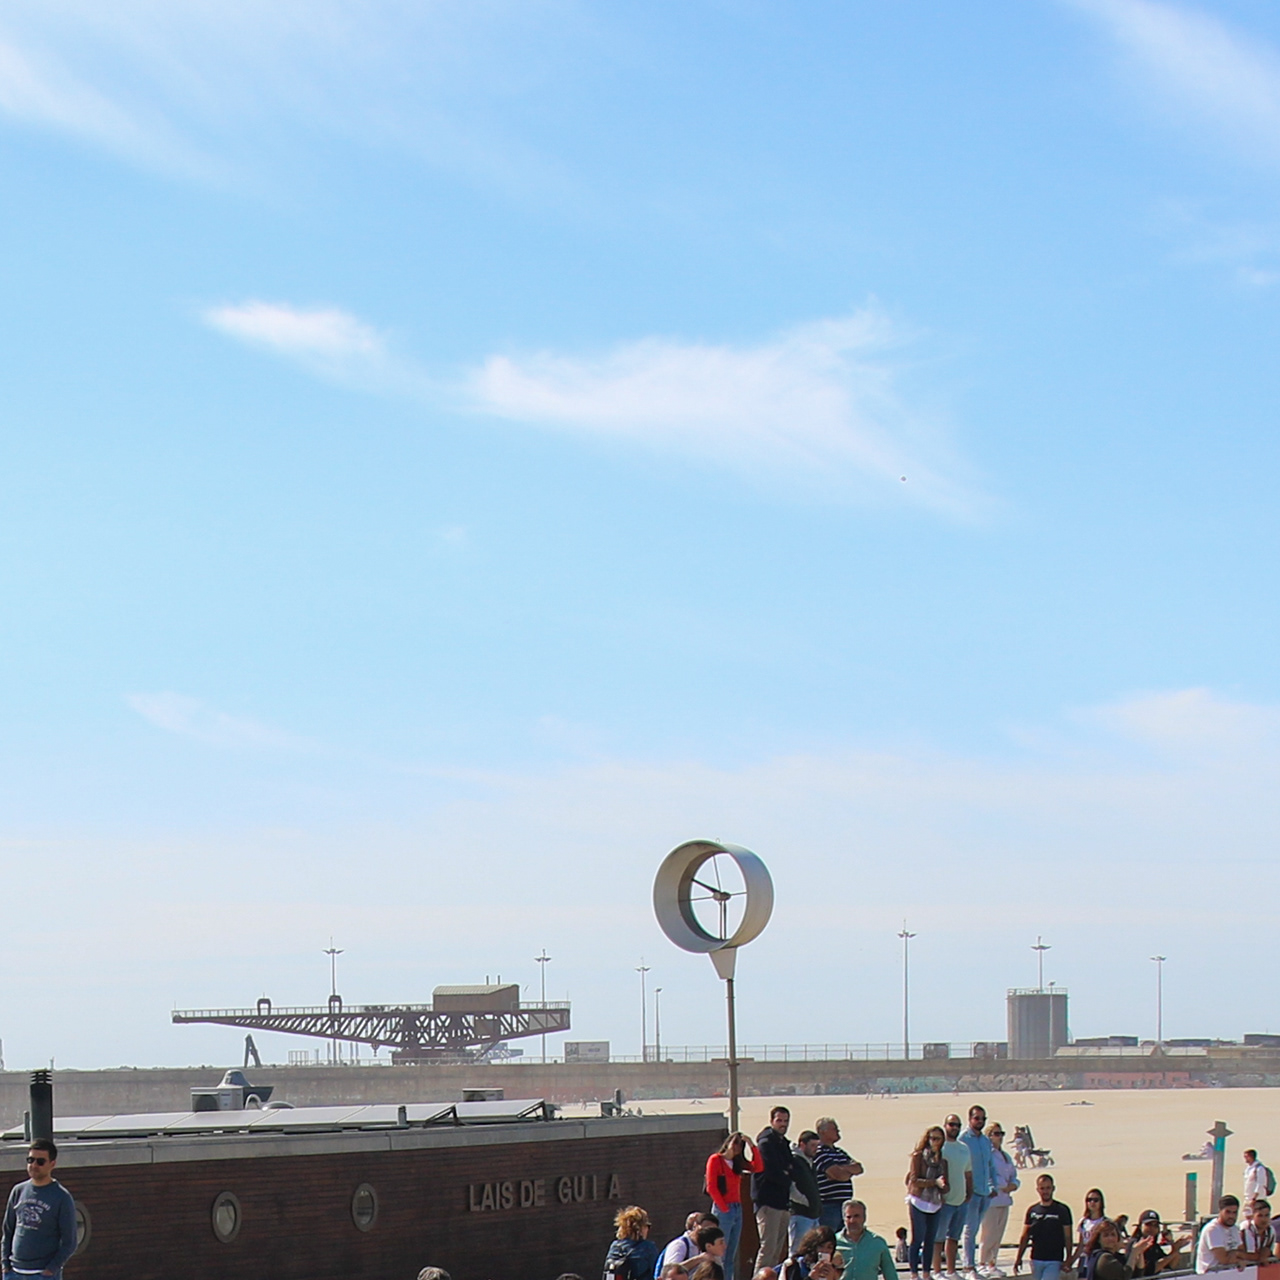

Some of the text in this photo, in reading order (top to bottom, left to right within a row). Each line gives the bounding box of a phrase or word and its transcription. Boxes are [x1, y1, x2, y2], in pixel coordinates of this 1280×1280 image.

[470, 1174, 621, 1211] LAIS DE GUIA
